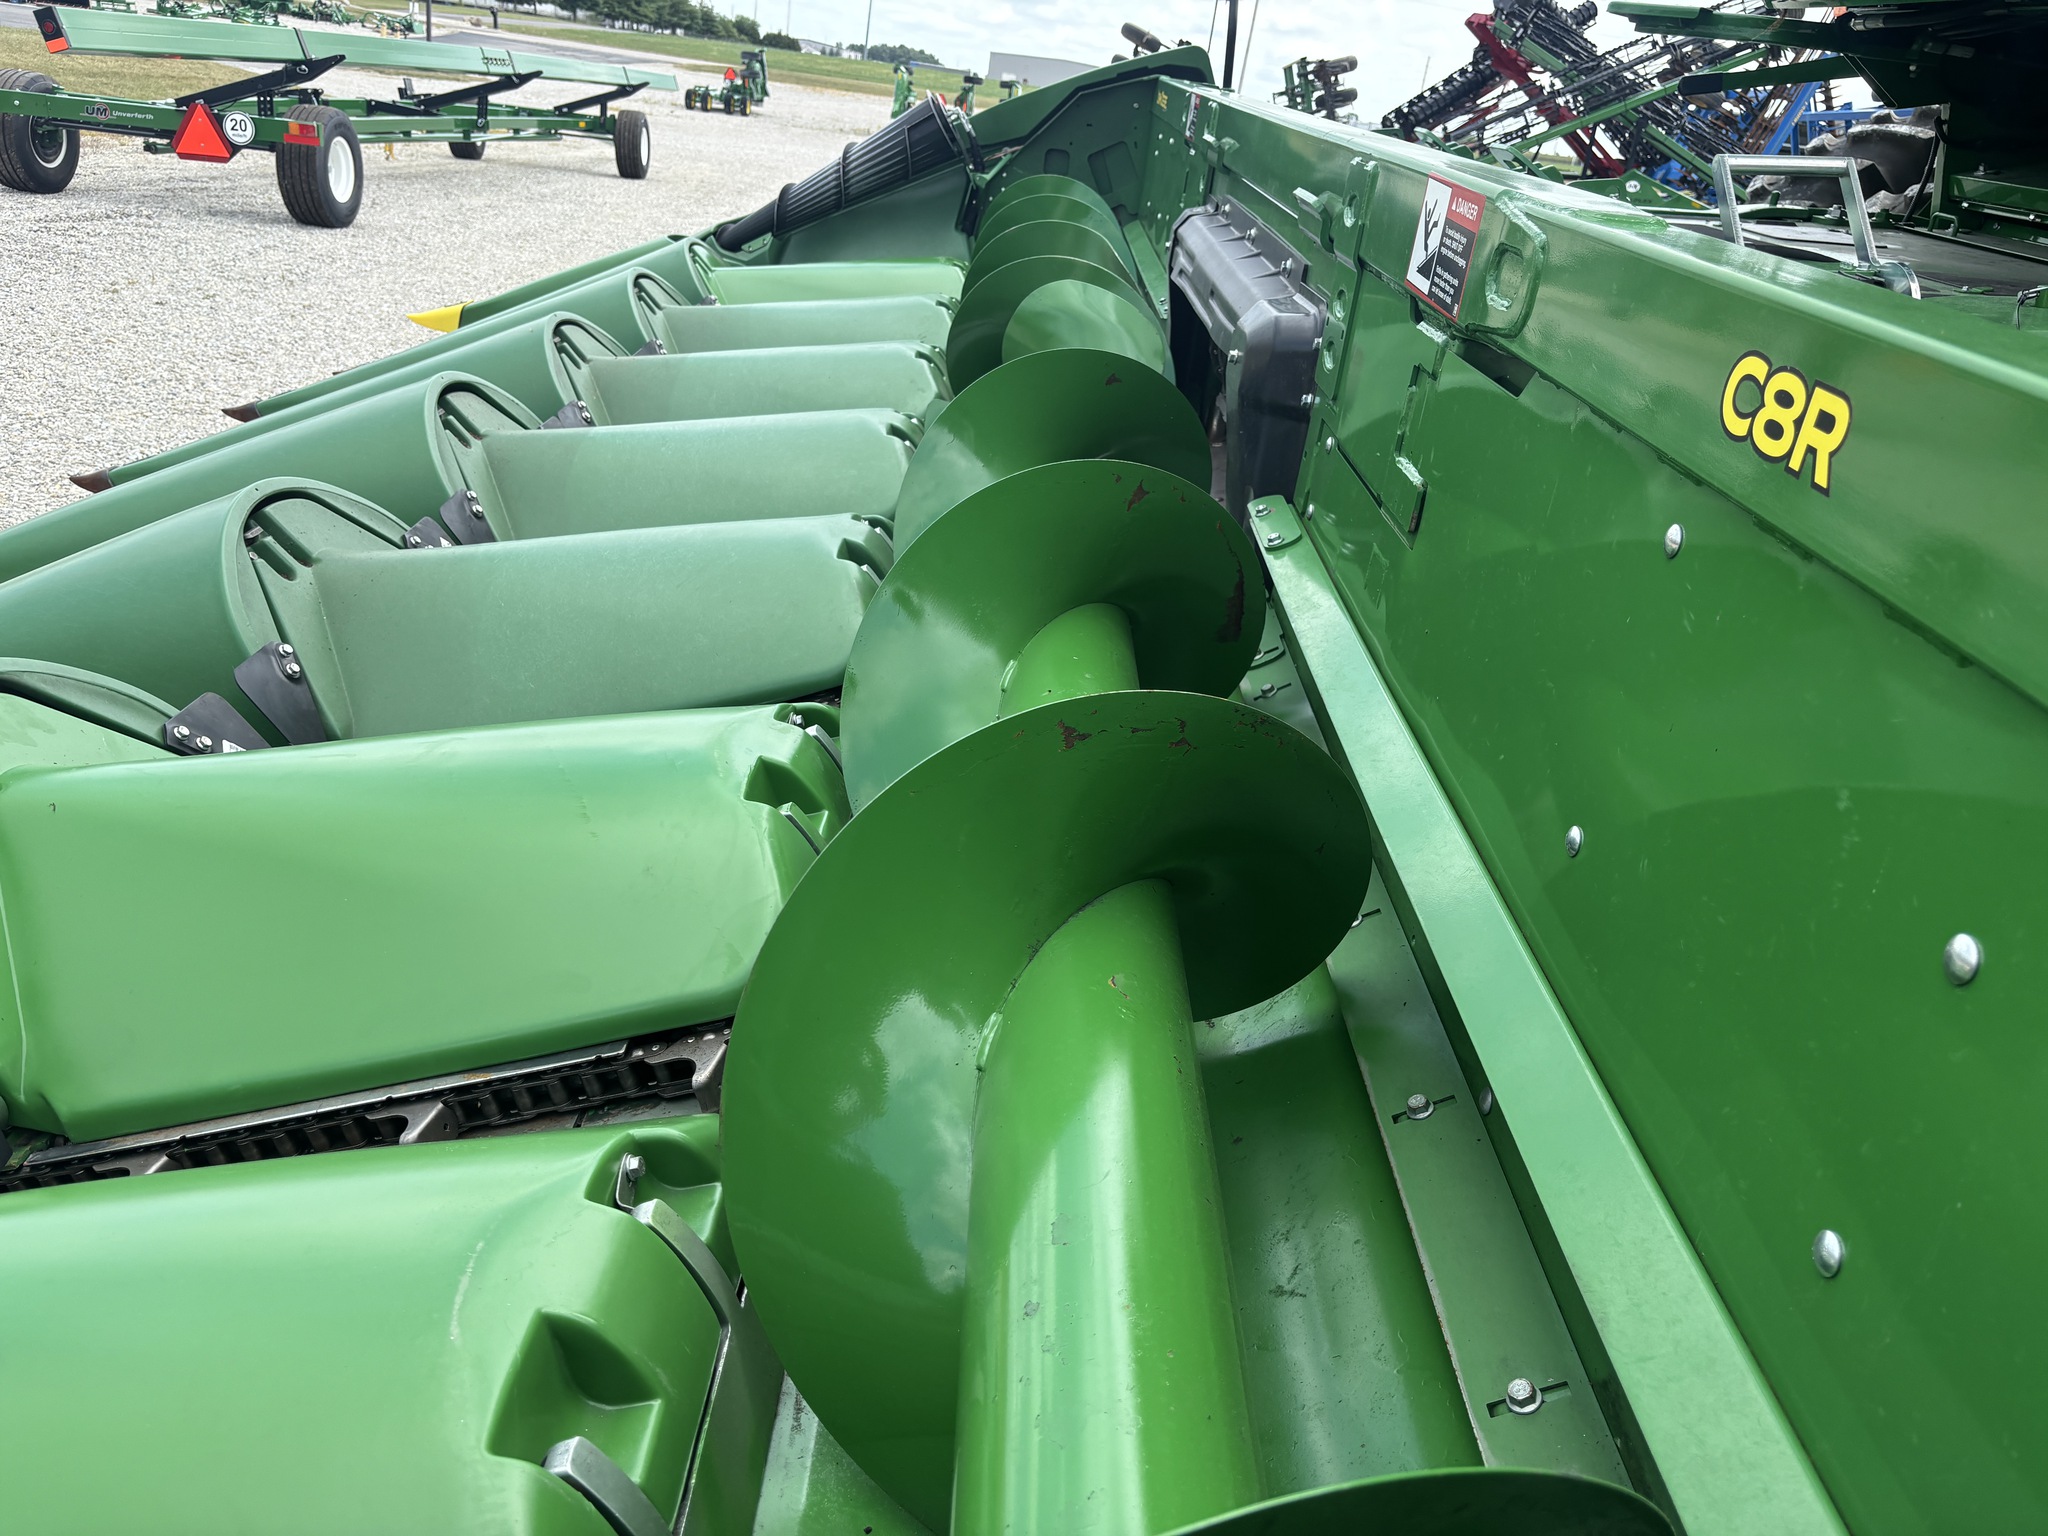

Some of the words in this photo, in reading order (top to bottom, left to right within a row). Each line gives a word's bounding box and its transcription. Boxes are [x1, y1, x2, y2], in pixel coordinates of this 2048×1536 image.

[112, 110, 154, 120] Unverferth
[230, 118, 247, 132] 20
[1456, 198, 1478, 222] DANGER
[1720, 350, 1852, 497] C8R
